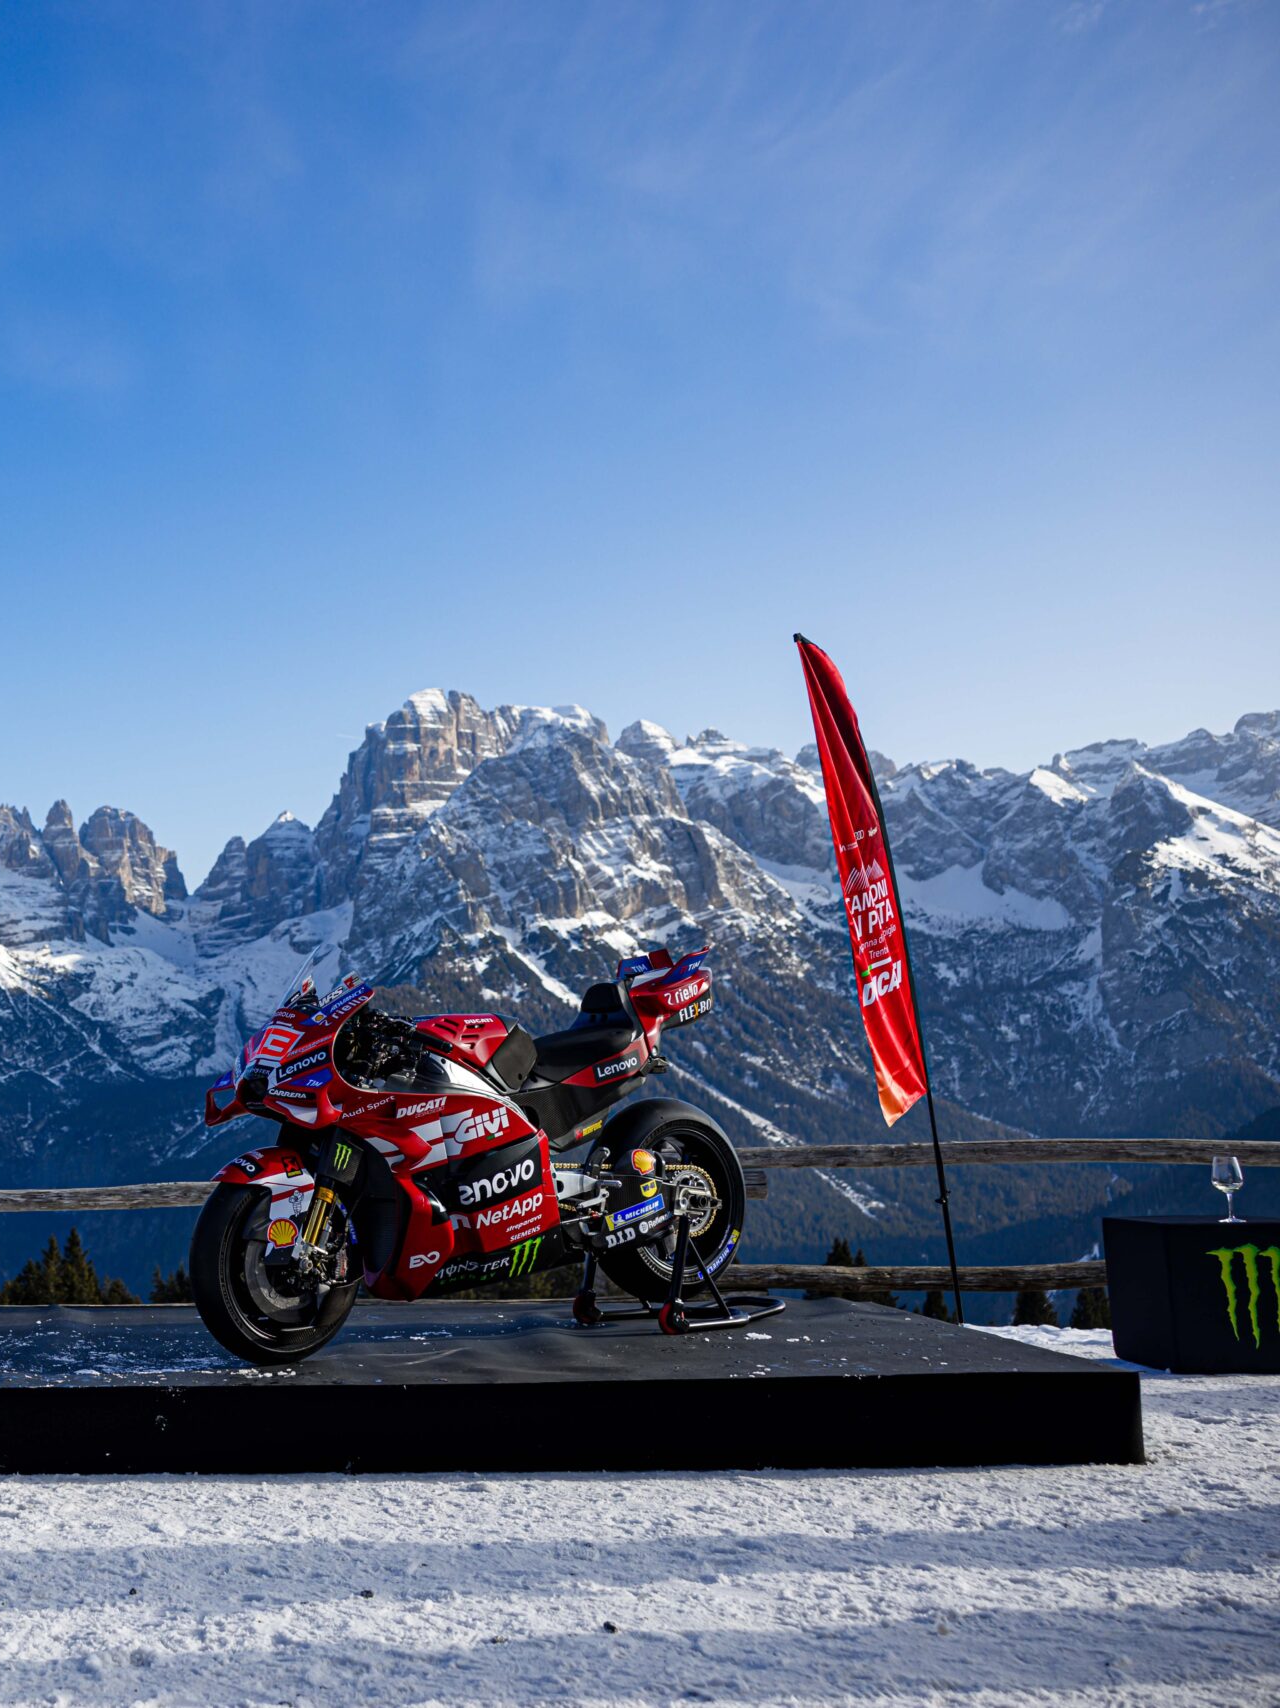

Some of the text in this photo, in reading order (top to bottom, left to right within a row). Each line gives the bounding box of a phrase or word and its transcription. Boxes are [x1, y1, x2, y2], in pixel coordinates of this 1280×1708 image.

[632, 964, 648, 973] TIM
[688, 961, 701, 971] TIM
[675, 983, 699, 1004] riello
[332, 995, 369, 1020] riello
[278, 1050, 327, 1078] Lenovo
[596, 1056, 638, 1078] Lenovo
[268, 1088, 307, 1099] CARRERA
[306, 1079, 322, 1087] TIM
[341, 1095, 396, 1120] Audi Sport
[396, 1096, 447, 1119] DUCATI
[454, 1106, 510, 1143] GIVI
[458, 1159, 535, 1206] enovo
[475, 1192, 543, 1230] NetApp
[624, 1200, 660, 1221] MICHELIN
[510, 1225, 541, 1242] SIEMENS
